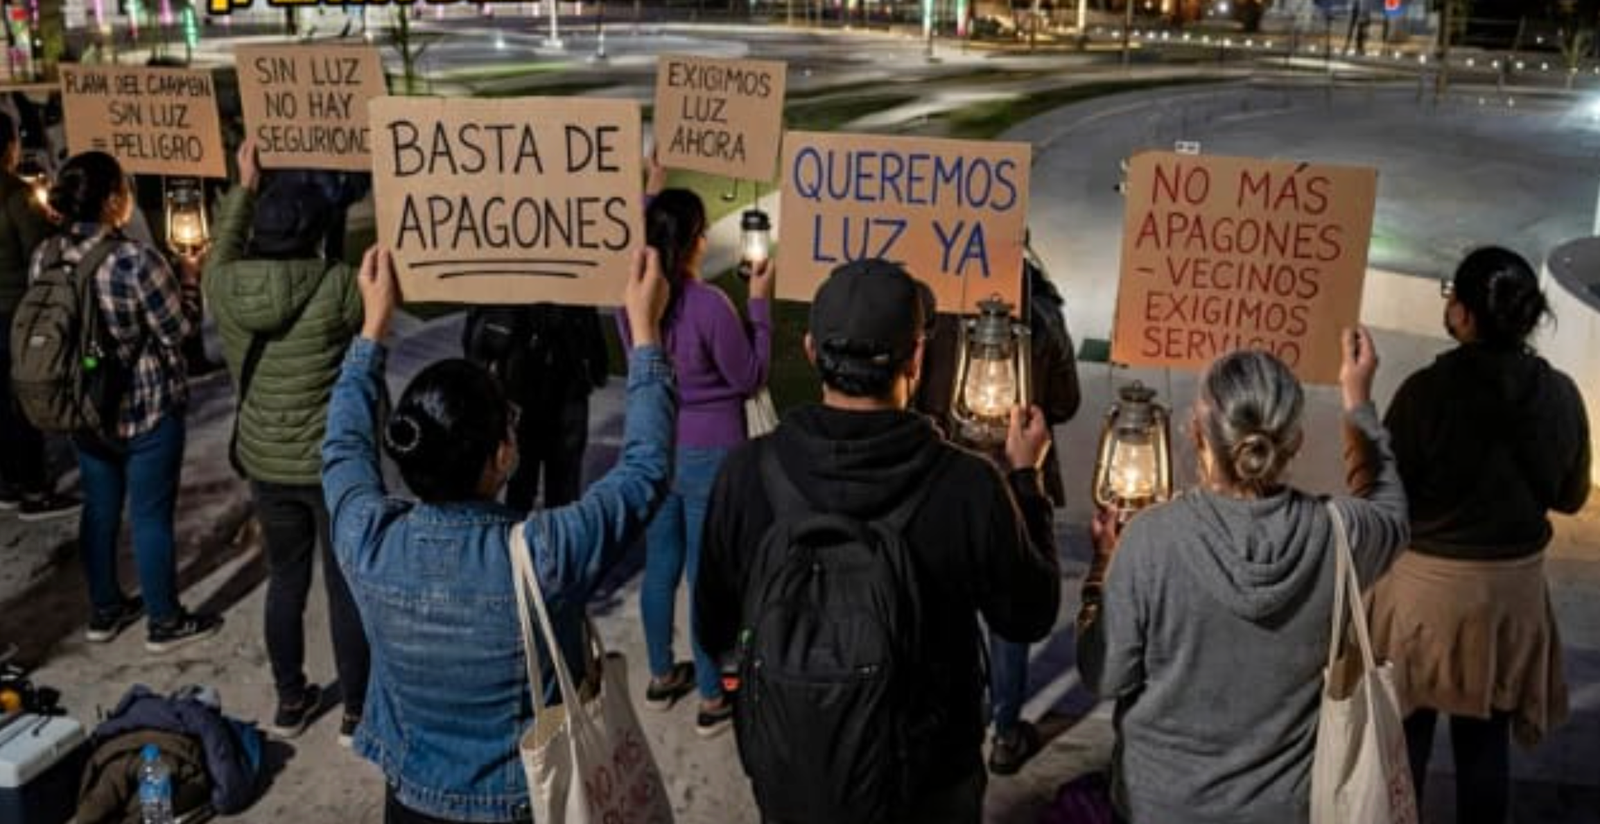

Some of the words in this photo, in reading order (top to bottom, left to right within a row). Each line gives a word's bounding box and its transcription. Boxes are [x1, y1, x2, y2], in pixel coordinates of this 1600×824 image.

[114, 74, 143, 96] DEL
[255, 57, 297, 84] SIN
[310, 57, 362, 85] LUZ
[668, 62, 771, 98] EXIGIMOS
[109, 101, 141, 126] SIN
[150, 104, 191, 129] LUZ
[264, 91, 297, 119] NO
[307, 91, 353, 119] HAY
[682, 96, 727, 123] LUZ
[112, 133, 204, 162] PELIGRO
[388, 120, 544, 178] BASTA
[565, 125, 620, 173] DE
[668, 126, 746, 162] AHORA
[793, 146, 1017, 212] QUEREMOS
[1152, 163, 1210, 206] NO
[1237, 162, 1333, 216] MÁS
[396, 194, 631, 252] APAGONES
[1135, 211, 1342, 262] APAGONES
[812, 214, 907, 263] LUZ
[932, 219, 991, 278] YA
[1166, 257, 1320, 300] VECINOS
[1144, 290, 1311, 338] EXIGIMOS
